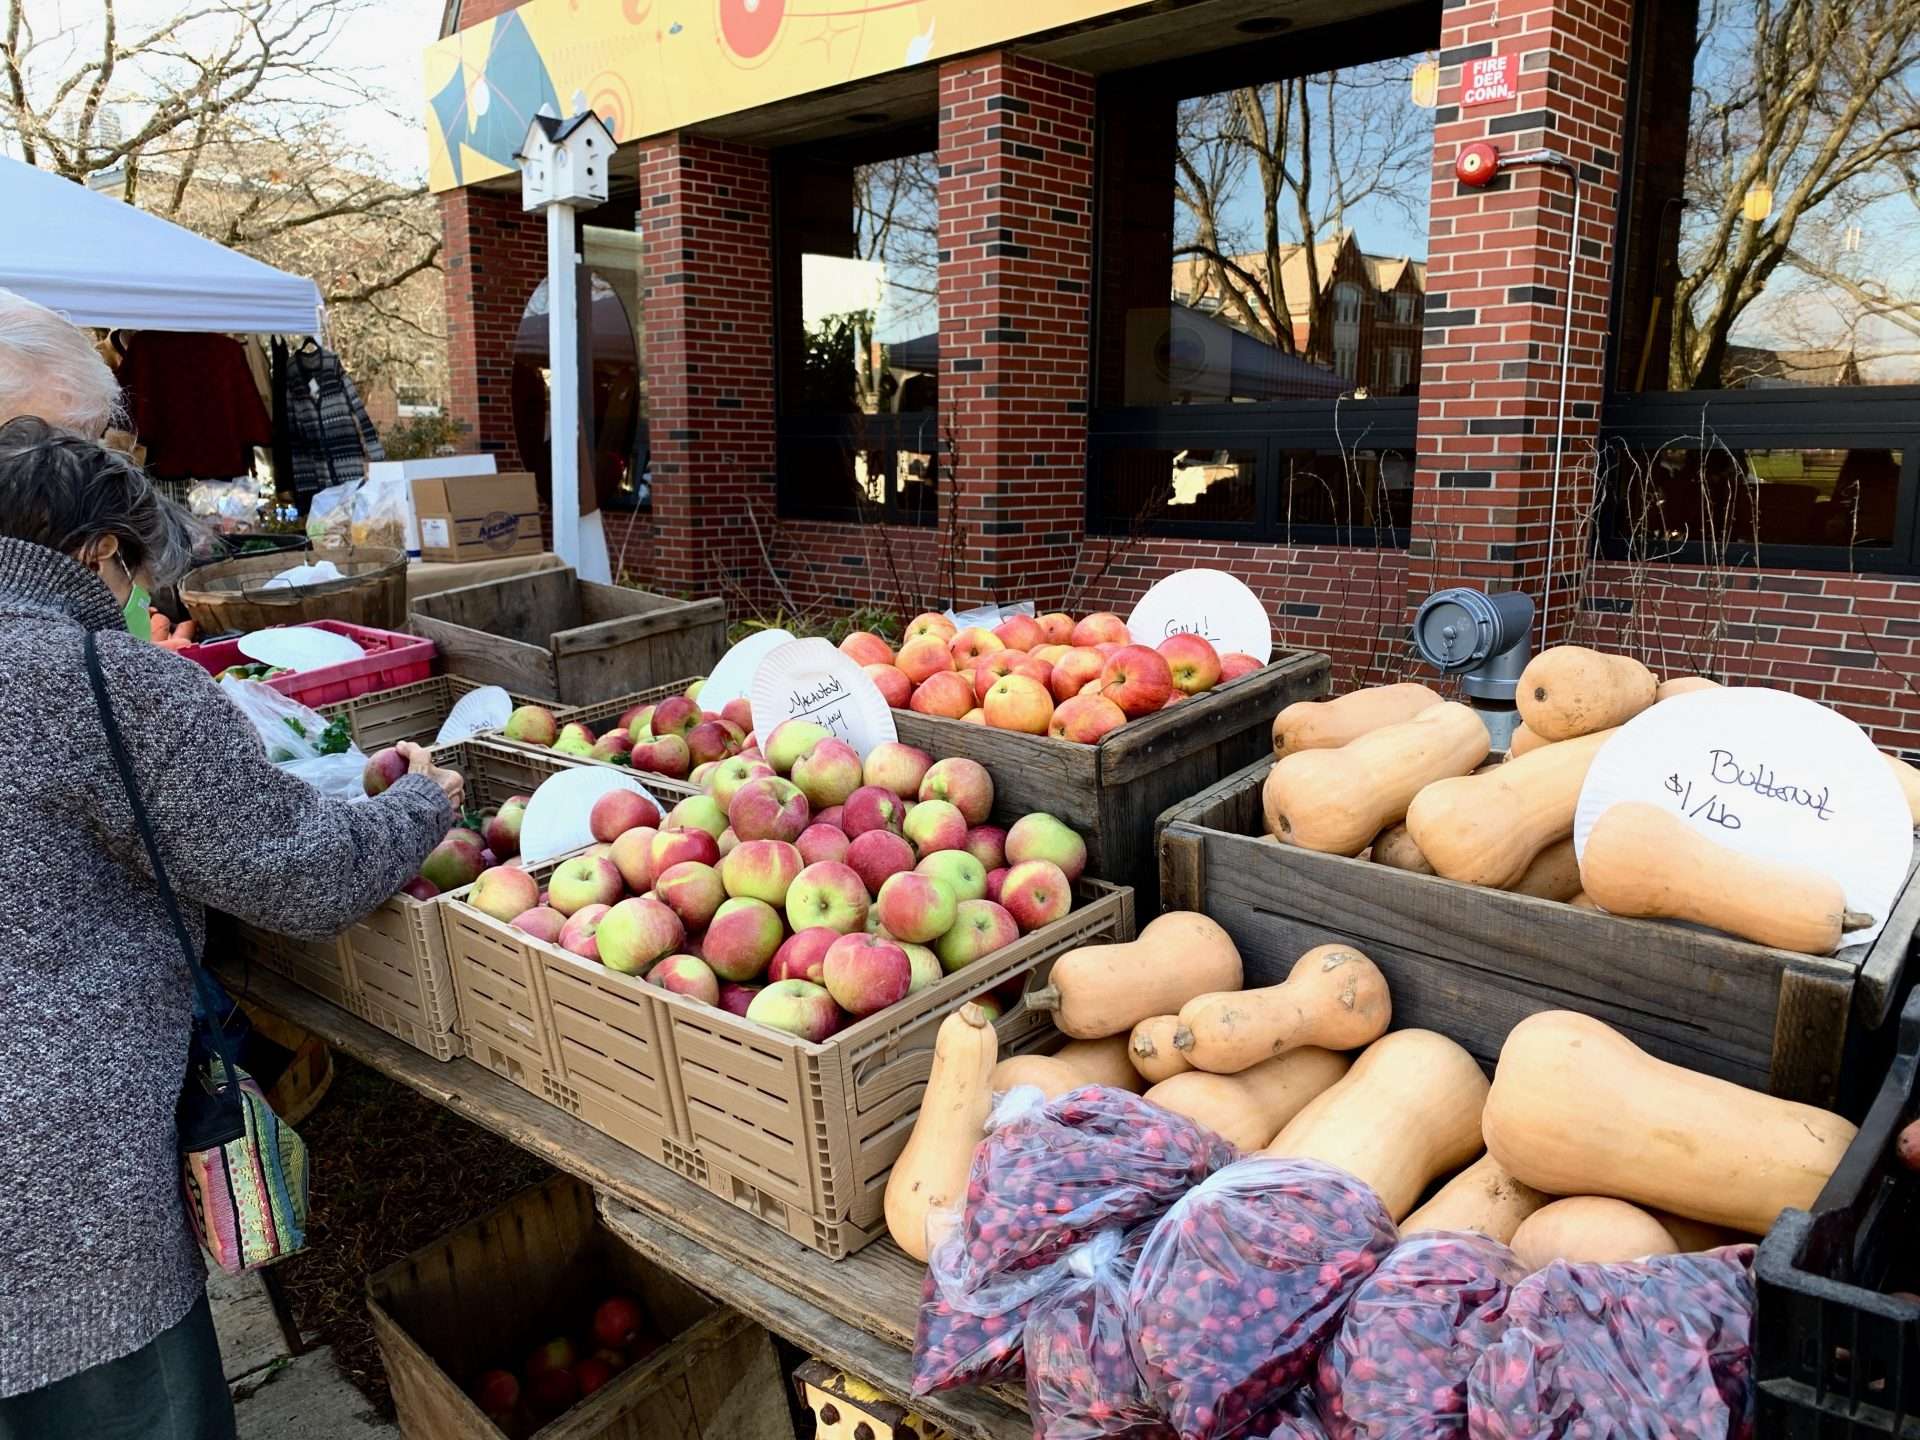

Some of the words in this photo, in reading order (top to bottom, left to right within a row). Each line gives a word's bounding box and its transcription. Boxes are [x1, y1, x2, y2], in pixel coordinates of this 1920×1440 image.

[1473, 56, 1508, 75] FIRE
[1474, 71, 1505, 88] DEP.
[1710, 750, 1835, 821] Butternut
